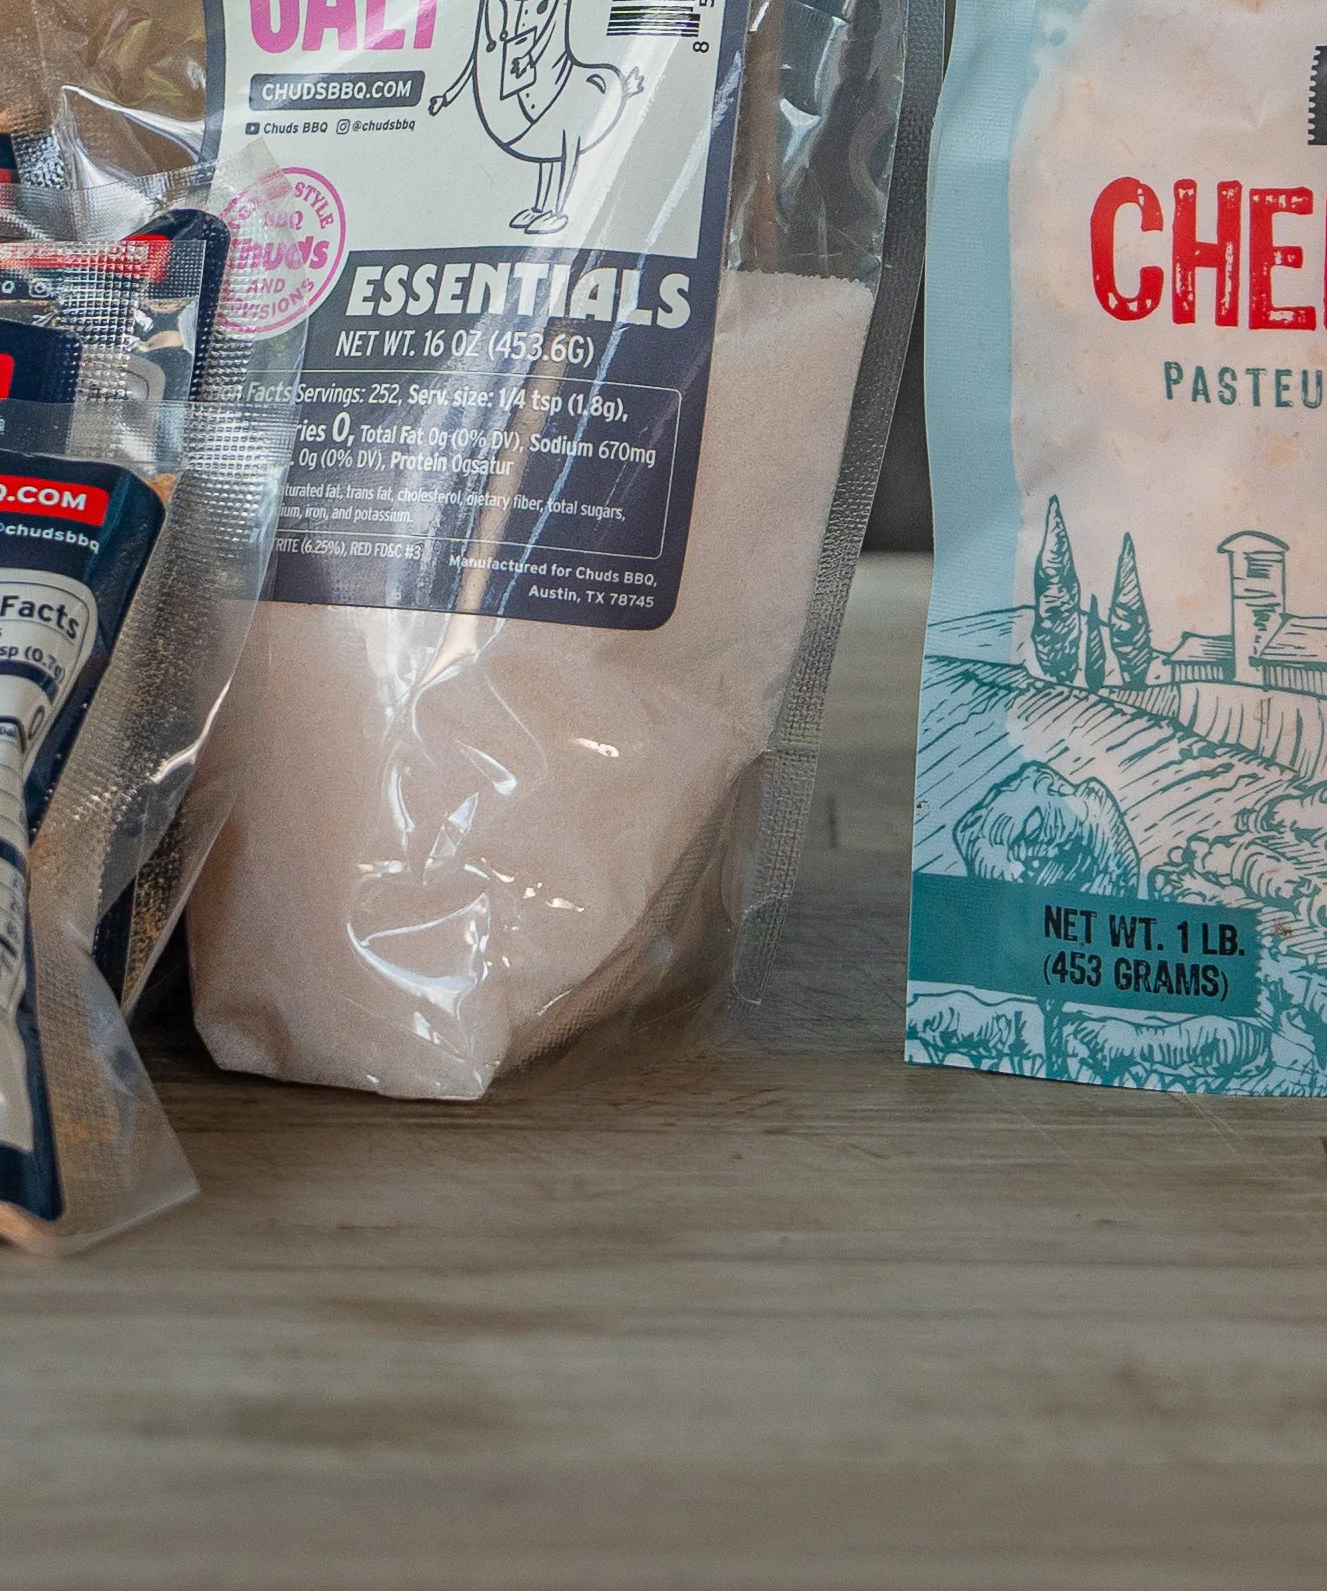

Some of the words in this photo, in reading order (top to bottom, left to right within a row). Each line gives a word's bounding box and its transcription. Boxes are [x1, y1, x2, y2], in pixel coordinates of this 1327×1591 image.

[262, 80, 412, 101] CHUDSBBQ.COM
[264, 122, 299, 134] Chuds
[303, 122, 328, 133] BBQ
[353, 119, 415, 132] @chudsbbq
[294, 182, 334, 229] STYLE
[346, 262, 690, 329] ESSENTIALS
[335, 329, 376, 357] NET
[384, 330, 415, 357] WT.
[423, 331, 444, 357] 16
[451, 332, 480, 357] OZ
[488, 331, 595, 368] (453.6G)
[296, 383, 365, 409] Servings:
[368, 384, 402, 406] 252,
[408, 384, 448, 407] Serv.
[452, 391, 494, 408] size:
[498, 388, 525, 408] 1/4
[531, 391, 562, 415] tsp
[320, 449, 352, 469] (0%
[390, 451, 446, 472] Protein
[360, 425, 397, 444] Total
[399, 425, 423, 445] Fat
[529, 433, 593, 458] Sodium
[598, 441, 656, 468] 670mg
[325, 485, 344, 500] fat,
[346, 486, 374, 500] trans
[377, 486, 394, 501] fat,
[398, 487, 463, 506] cholesterol,
[466, 492, 510, 512] dietary
[513, 496, 544, 513] fiber,
[547, 498, 577, 515] total
[581, 504, 626, 521] sugars,
[332, 507, 351, 520] and
[353, 507, 413, 523] potassium.
[350, 543, 371, 556] RED
[449, 555, 547, 575] Manufactured
[551, 564, 571, 578] for
[575, 567, 619, 582] Chuds
[624, 572, 657, 587] BBQ,
[528, 585, 580, 602] Austin,
[586, 591, 604, 604] TX
[610, 594, 654, 608] 78745
[1, 595, 79, 639] Facts
[1044, 905, 1097, 944] NET
[1109, 914, 1164, 950] WT.
[1177, 920, 1188, 954] 1
[1202, 922, 1245, 956] LB.
[1044, 950, 1102, 986] (453
[1114, 957, 1229, 1002] GRAMS)
